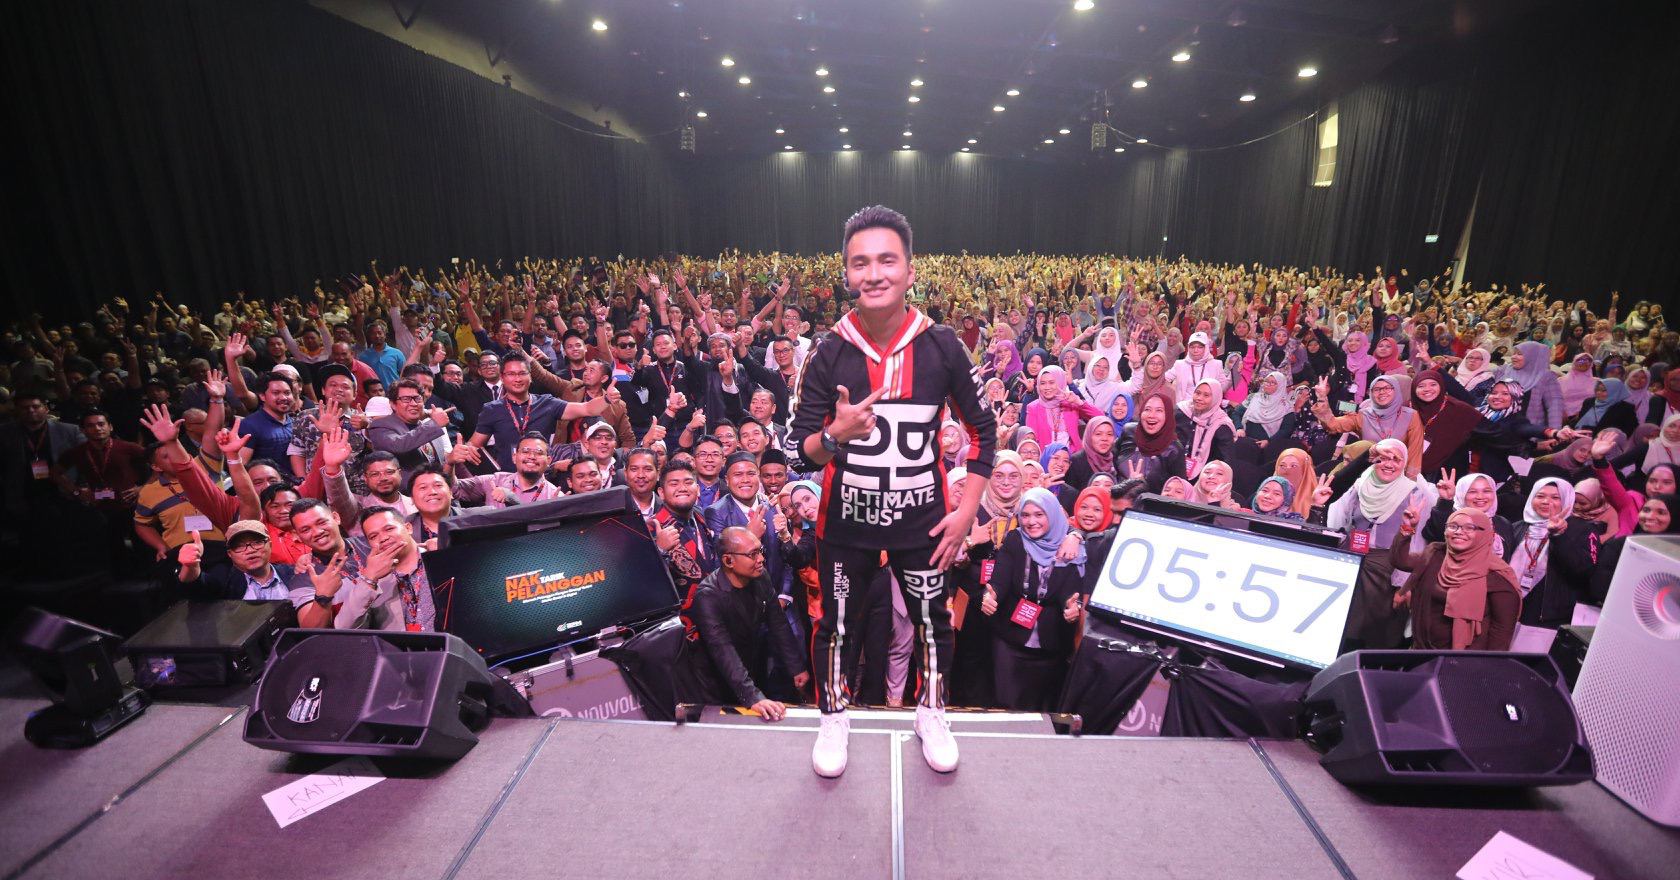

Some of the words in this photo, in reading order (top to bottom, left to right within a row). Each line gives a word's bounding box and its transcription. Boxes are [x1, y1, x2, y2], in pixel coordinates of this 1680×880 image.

[841, 502, 893, 526] PLUS
[505, 573, 541, 593] NAK
[506, 569, 605, 603] PELANGGAN
[1108, 537, 1349, 634] 05:57
